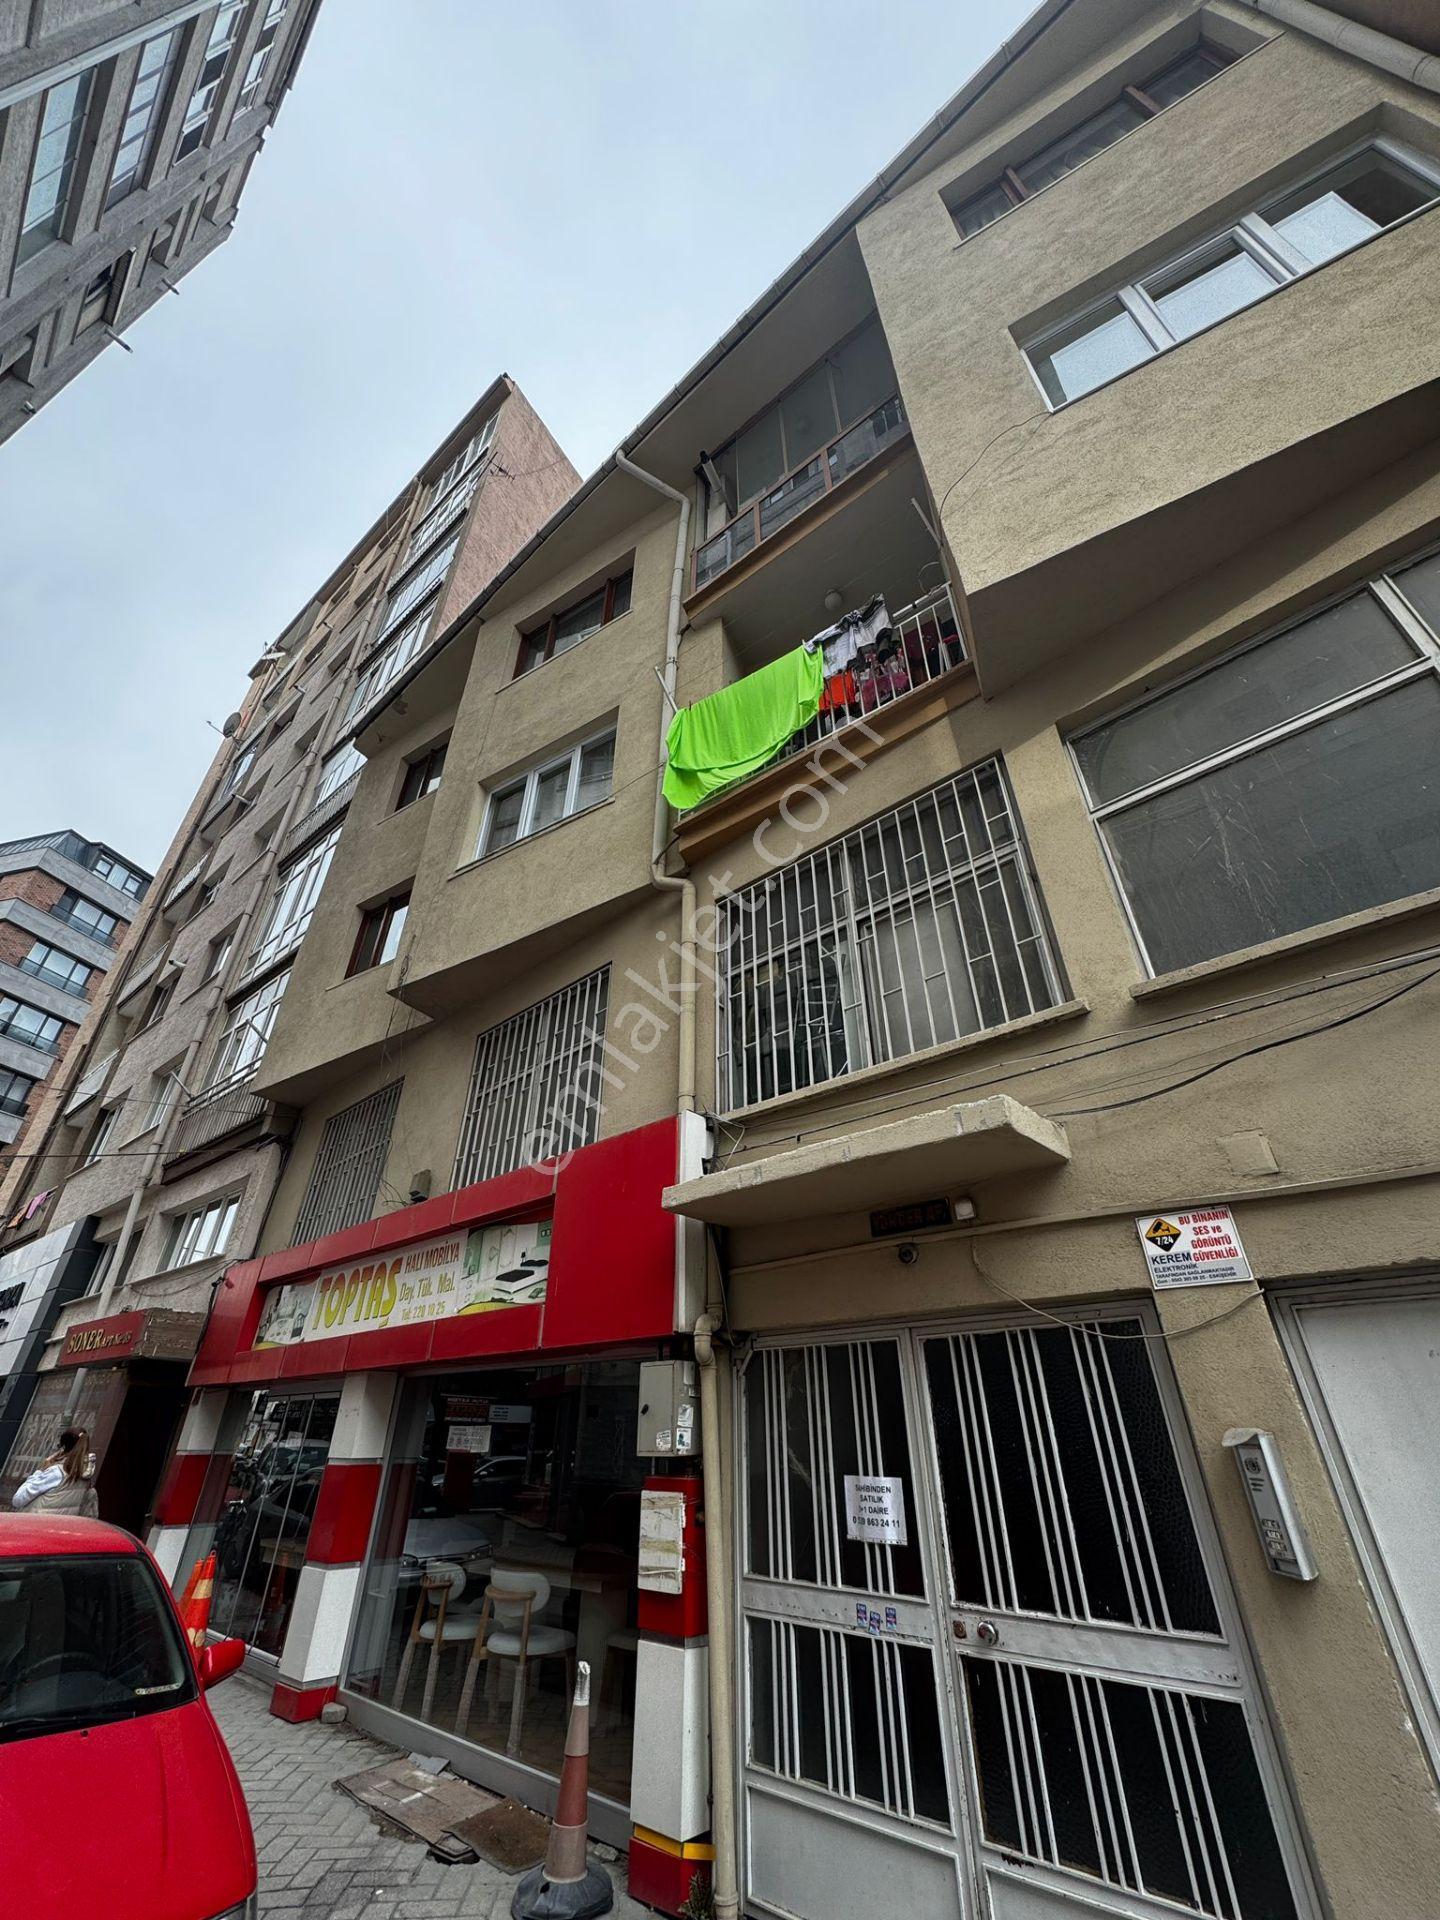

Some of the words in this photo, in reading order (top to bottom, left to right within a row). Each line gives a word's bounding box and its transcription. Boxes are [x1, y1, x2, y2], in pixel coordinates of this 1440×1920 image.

[1178, 1216, 1190, 1225] BU
[1192, 1210, 1229, 1223] BİNANIN
[1193, 1225, 1209, 1236] SES
[1211, 1225, 1222, 1233] ve
[1155, 1236, 1174, 1245] 7/24
[1191, 1235, 1232, 1249] GÖRÜNTÜ
[404, 1252, 424, 1274] HALI
[425, 1240, 460, 1268] MOBİLYA
[1151, 1252, 1192, 1265] KEREM
[1193, 1246, 1239, 1262] GÜVENLİĞİ
[1154, 1263, 1198, 1273] ELEKTRONİK
[312, 1257, 404, 1330] TOPTAŞ
[67, 1329, 104, 1354] SONER
